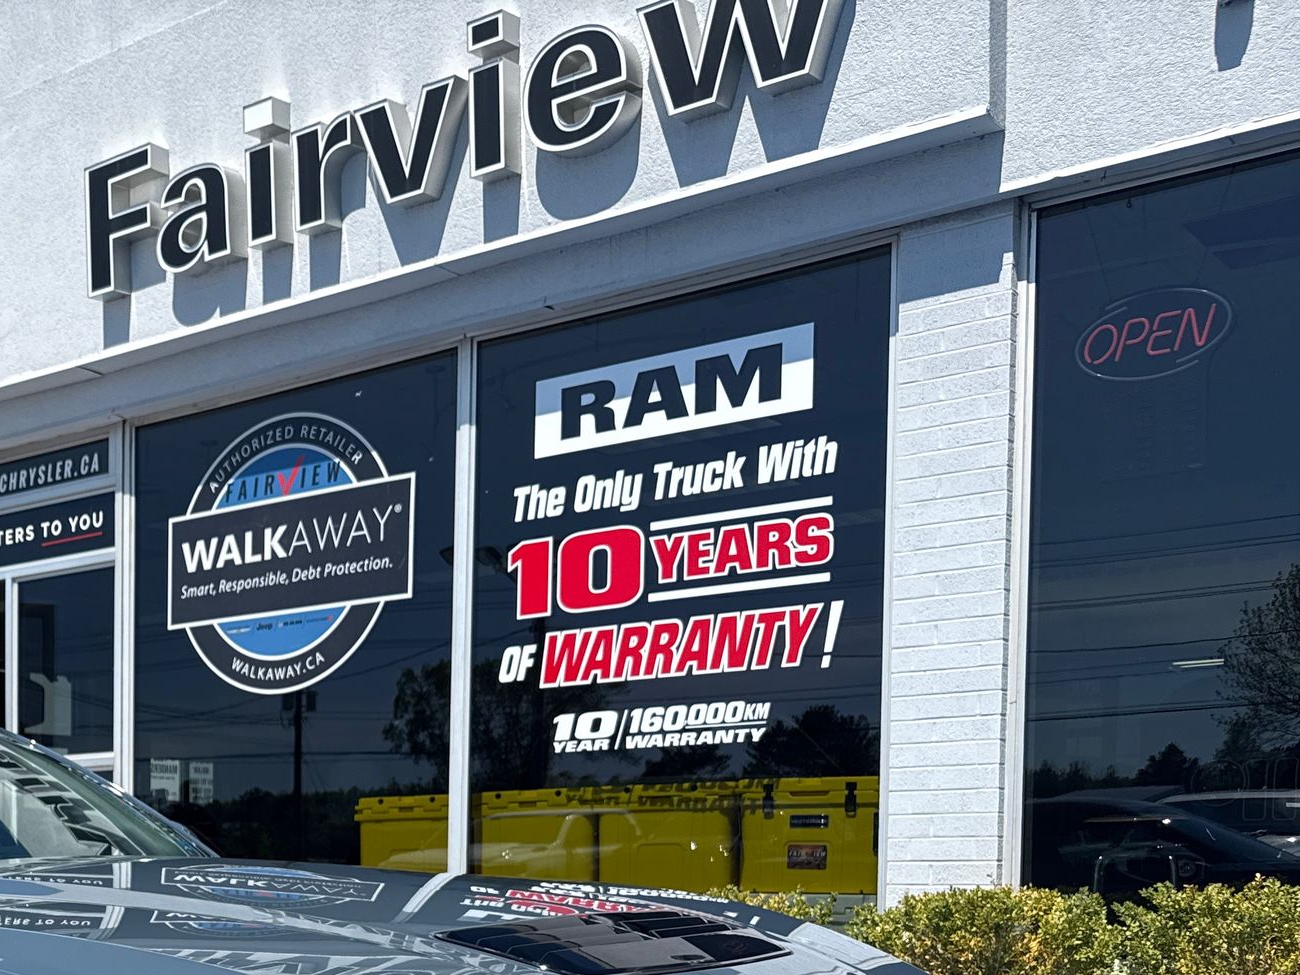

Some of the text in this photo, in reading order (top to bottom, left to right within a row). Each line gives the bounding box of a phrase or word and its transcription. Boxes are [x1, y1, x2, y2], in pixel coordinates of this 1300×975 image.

[84, 0, 830, 297] Fairview
[1083, 303, 1216, 364] OPEN
[560, 342, 783, 441] RAM
[208, 425, 364, 494] AUTHORIZED RETAILER
[513, 435, 838, 522] The Only Truck With
[41, 520, 62, 538] TO
[68, 511, 104, 532] YOU
[181, 556, 393, 599] Smart, Responsible, Debt Protection.
[507, 512, 834, 620] 10 YEARS
[231, 651, 325, 681] WALKAWAY.CA
[499, 644, 538, 683] OF
[553, 710, 618, 741] 10
[553, 727, 767, 753] YEAR WARRANTY
